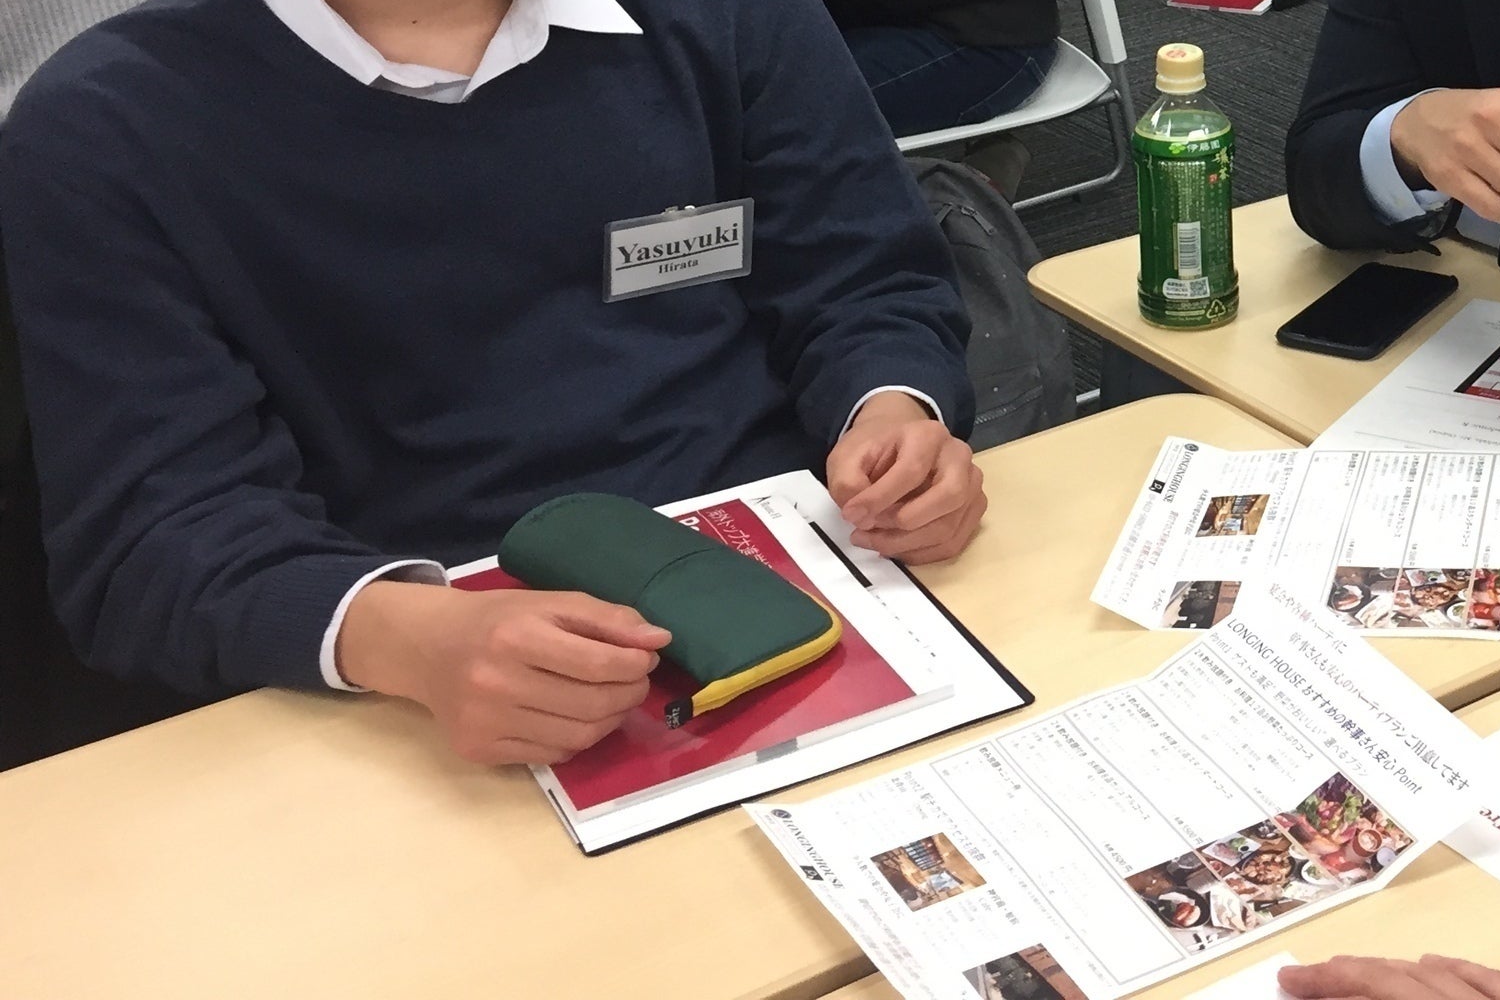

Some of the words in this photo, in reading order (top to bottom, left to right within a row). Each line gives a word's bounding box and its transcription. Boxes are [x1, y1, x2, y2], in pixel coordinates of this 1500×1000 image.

[616, 222, 739, 264] Yasuyuki
[657, 258, 699, 274] Hirata
[1223, 617, 1277, 660] LONGING
[1266, 655, 1309, 688] HOUSE
[1298, 684, 1402, 771] おすすめの幹事さん安心
[1390, 766, 1428, 795] Point
